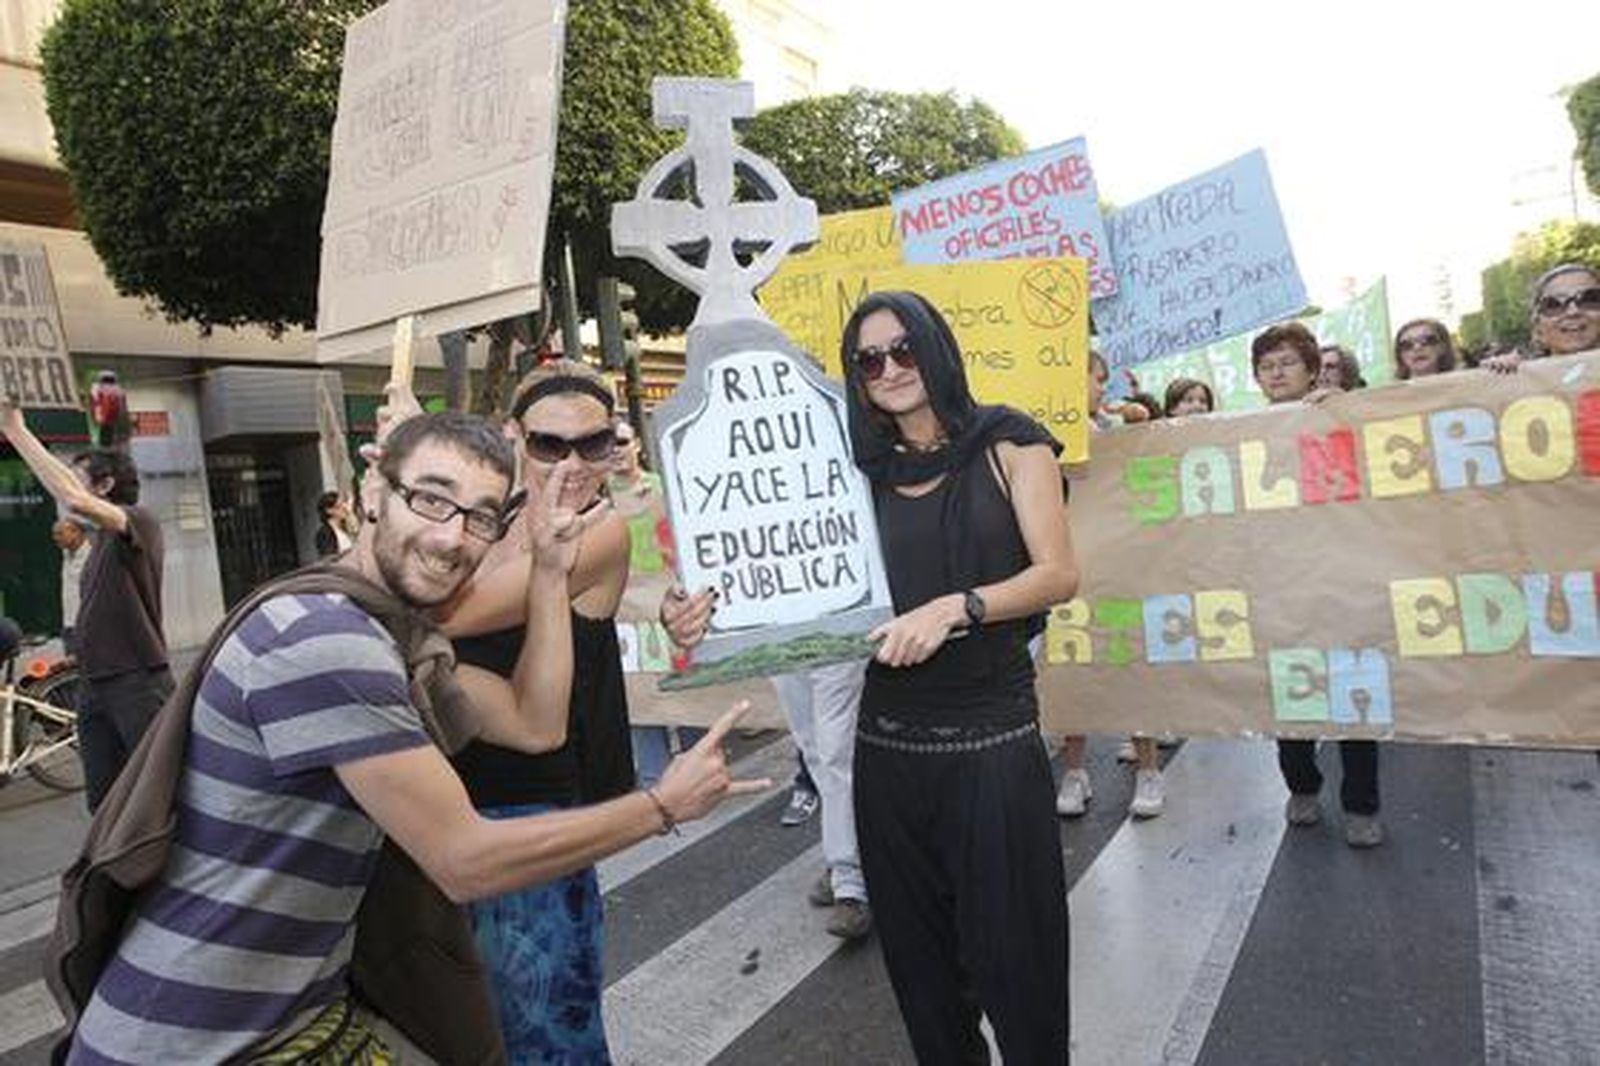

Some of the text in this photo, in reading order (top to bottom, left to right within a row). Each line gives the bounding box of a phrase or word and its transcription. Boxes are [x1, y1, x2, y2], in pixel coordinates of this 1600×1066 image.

[901, 185, 1004, 239] MENOS
[1037, 337, 1072, 366] al
[693, 458, 849, 514] YACE LA
[693, 507, 859, 569] EDUCACIÓN
[1045, 589, 1255, 665] RTES
[1389, 571, 1600, 659] EDU
